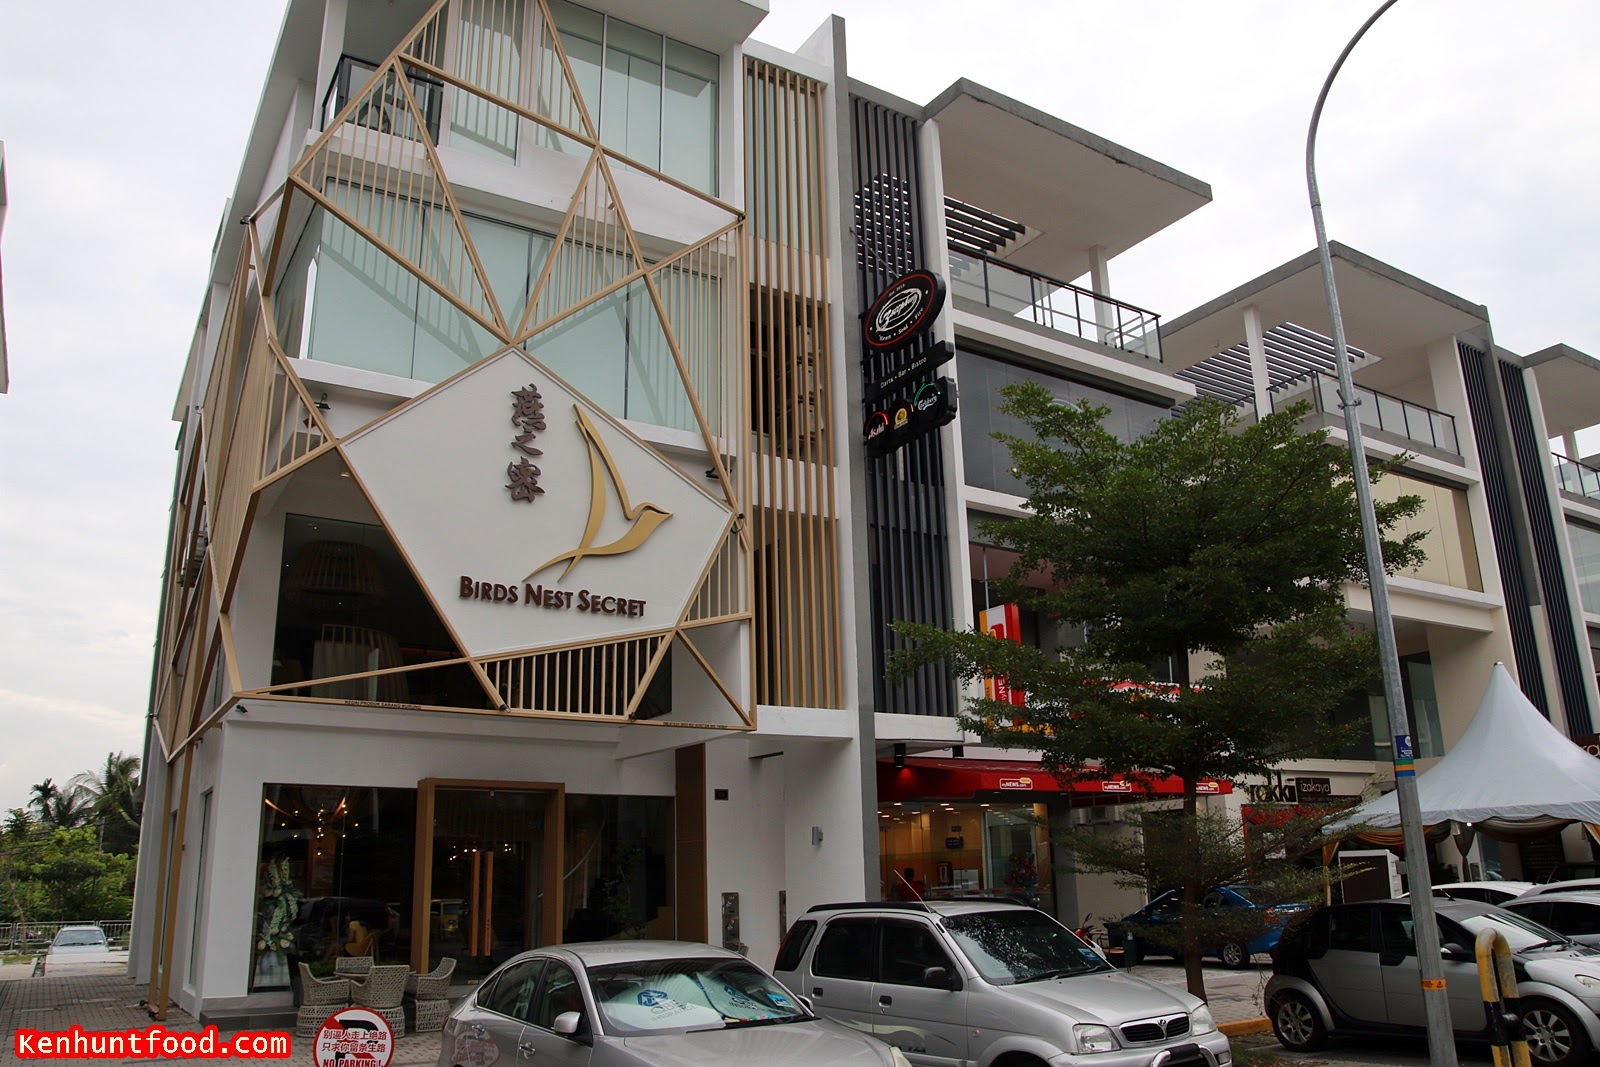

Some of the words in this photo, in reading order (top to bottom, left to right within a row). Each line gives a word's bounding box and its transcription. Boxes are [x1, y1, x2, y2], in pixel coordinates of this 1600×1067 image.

[880, 377, 894, 388] Darts
[898, 368, 907, 378] Bar
[912, 357, 927, 370] Bistro
[459, 575, 518, 604] BIRDS
[525, 582, 574, 610] NEST
[576, 589, 647, 618] SECRET
[324, 1030, 387, 1040] 别逼人走上绝路
[322, 1042, 386, 1052] 只求你留条生路
[324, 1058, 334, 1067] NO
